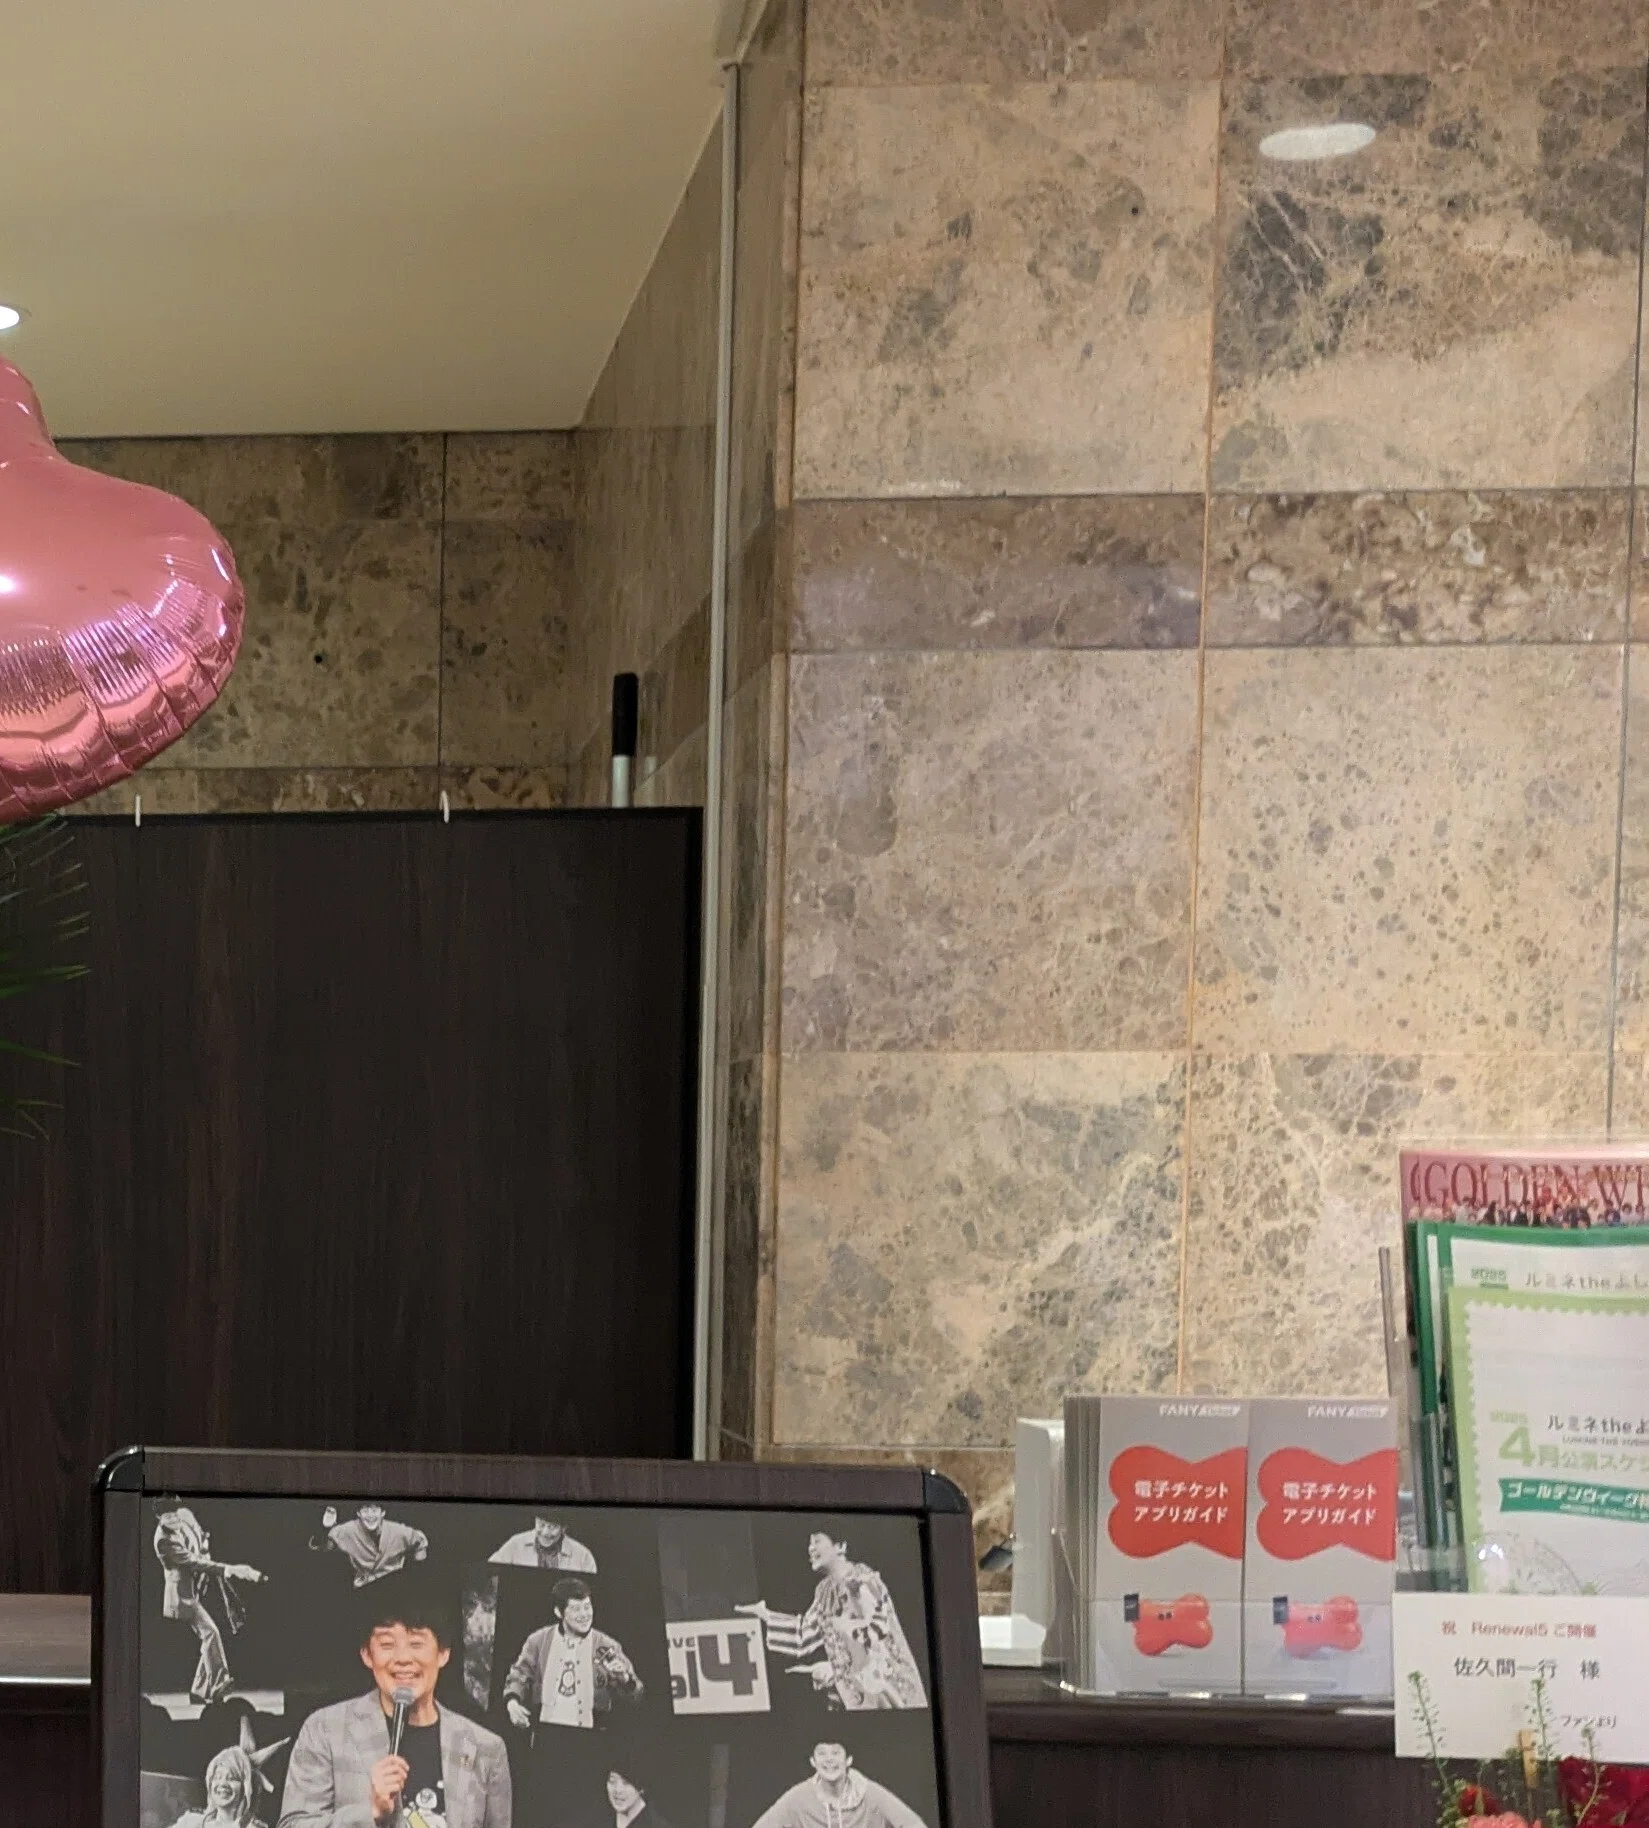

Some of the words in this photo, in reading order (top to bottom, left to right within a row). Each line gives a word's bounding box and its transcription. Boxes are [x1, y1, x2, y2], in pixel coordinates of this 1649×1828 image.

[1134, 1479, 1229, 1499] 電子チケット
[1283, 1481, 1378, 1500] 電子チケット
[1134, 1506, 1229, 1524] アプリガイド
[1283, 1507, 1377, 1525] アプリガイド
[1454, 1656, 1557, 1679] 佐久間一行
[1580, 1658, 1600, 1680] 様
